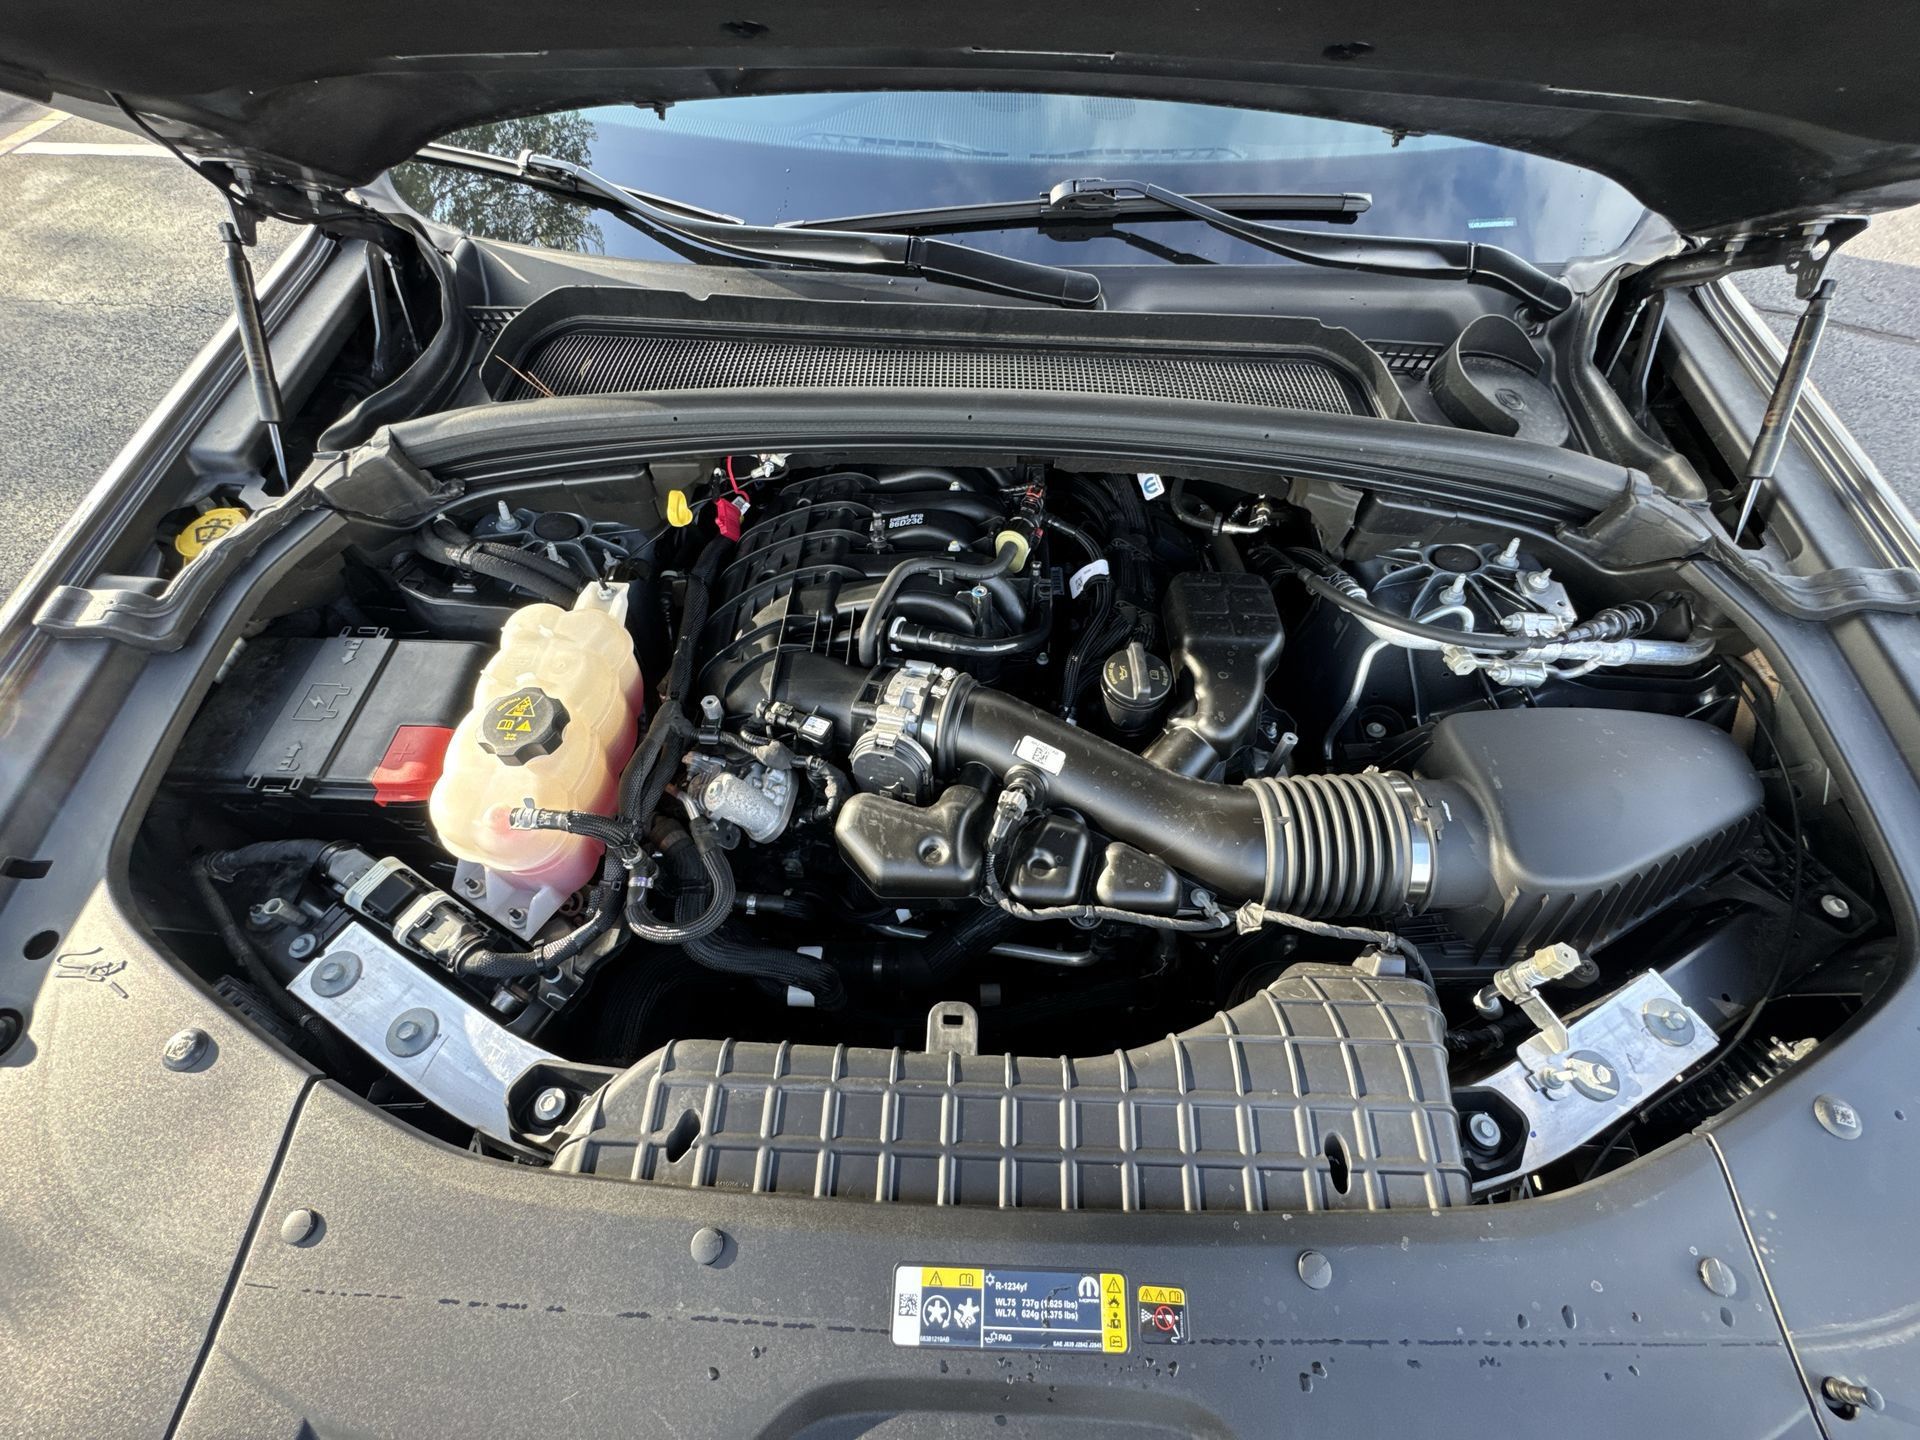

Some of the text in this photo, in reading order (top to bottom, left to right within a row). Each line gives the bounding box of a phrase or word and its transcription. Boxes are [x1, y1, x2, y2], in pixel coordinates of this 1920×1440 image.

[995, 1281, 1028, 1293] R-1234yf
[995, 1297, 1016, 1307] WL75
[1021, 1298, 1040, 1310] 737g
[1063, 1300, 1078, 1311] lbs)
[995, 1308, 1079, 1322] WL74 624g (1.375 lbs)
[998, 1334, 1012, 1343] PAG
